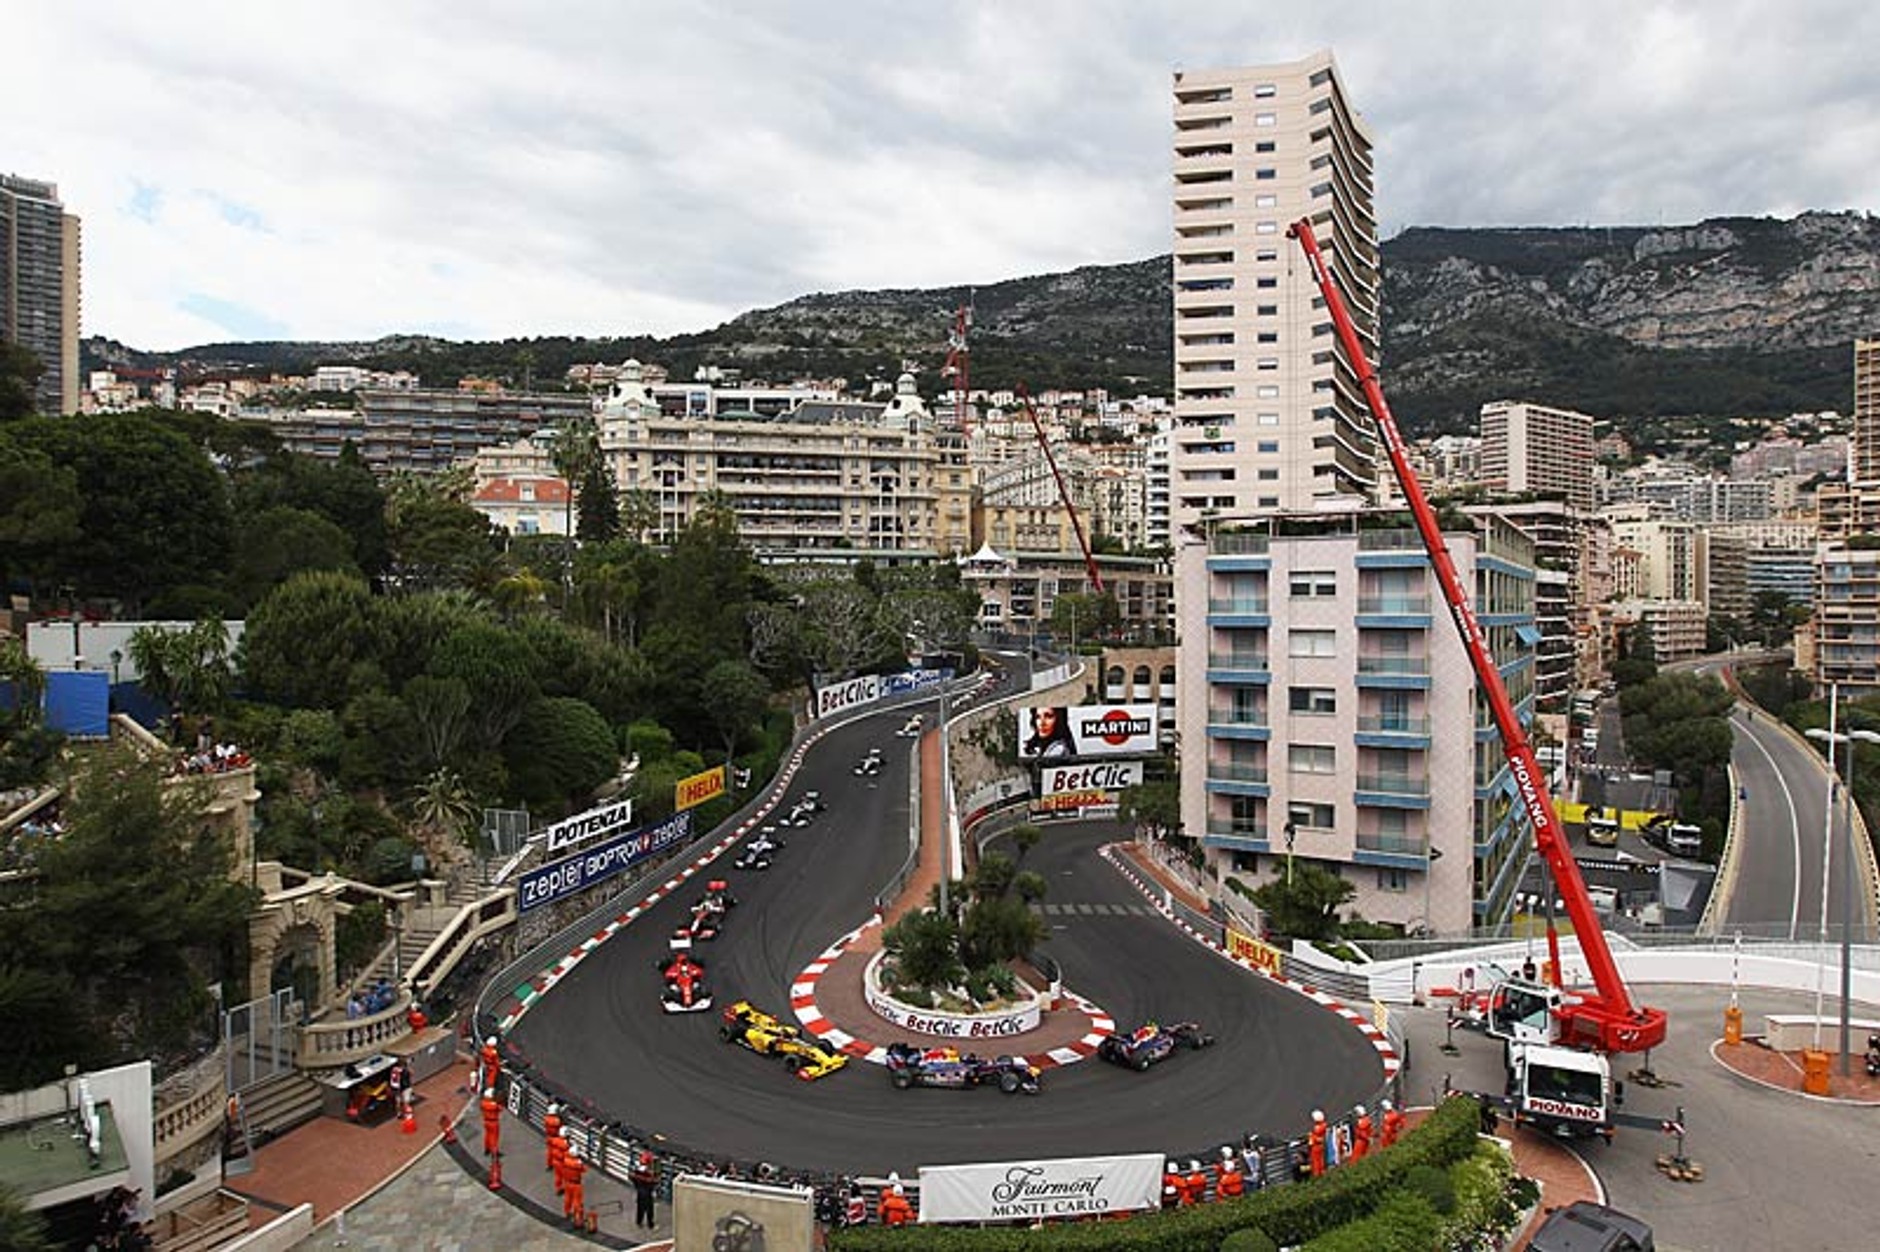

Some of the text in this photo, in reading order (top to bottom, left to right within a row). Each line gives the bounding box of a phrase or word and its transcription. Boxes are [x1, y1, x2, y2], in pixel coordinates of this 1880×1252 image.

[822, 679, 875, 712] BetClic
[1085, 720, 1147, 734] MARTINI
[1053, 765, 1131, 791] BetClic
[1511, 756, 1548, 828] PIOVANO
[553, 806, 627, 846] POTENZA
[587, 839, 640, 876] BIOPTRON
[1236, 937, 1276, 970] HELIX
[906, 1015, 961, 1035] BetClic
[970, 1017, 1023, 1036] BetClic
[1529, 1099, 1600, 1120] PIOVANO
[992, 1166, 1103, 1203] Fairmont
[992, 1199, 1108, 1217] MONTE CARLO
